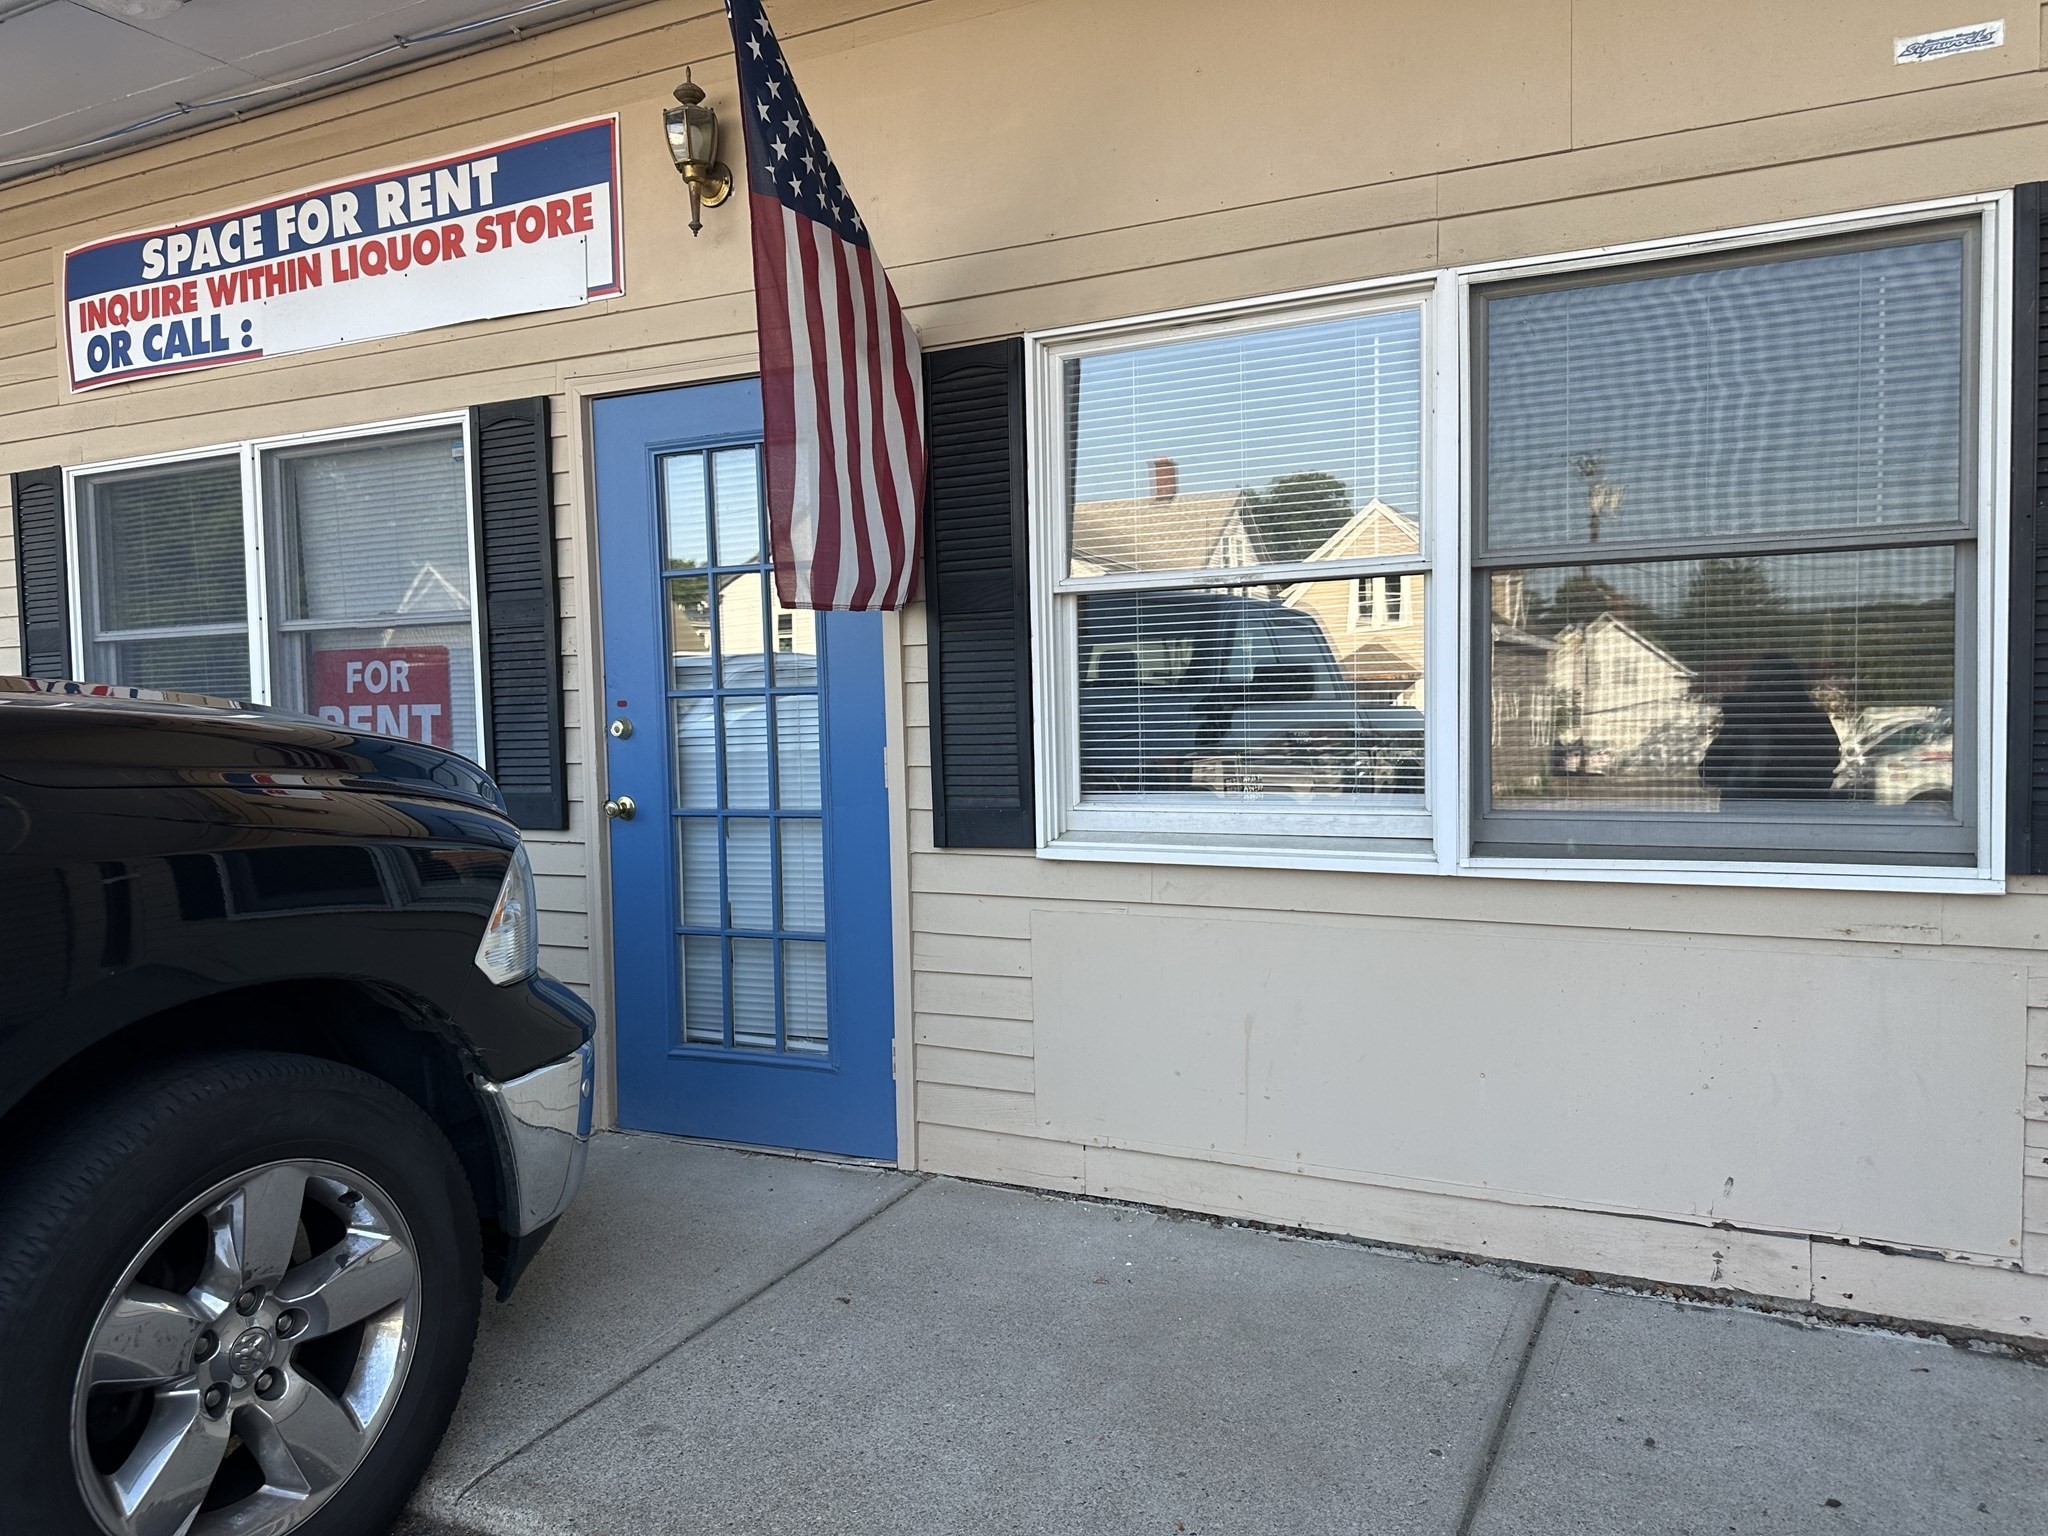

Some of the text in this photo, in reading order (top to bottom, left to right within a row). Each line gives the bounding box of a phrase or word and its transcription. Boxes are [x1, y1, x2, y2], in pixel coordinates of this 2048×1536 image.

[1898, 29, 1996, 58] Signworks
[142, 156, 498, 280] SPACE FOR RENT
[80, 193, 594, 333] INQUIRE WITHIN LIQUOR STORE
[87, 335, 134, 373] OR
[347, 660, 410, 694] FOR
